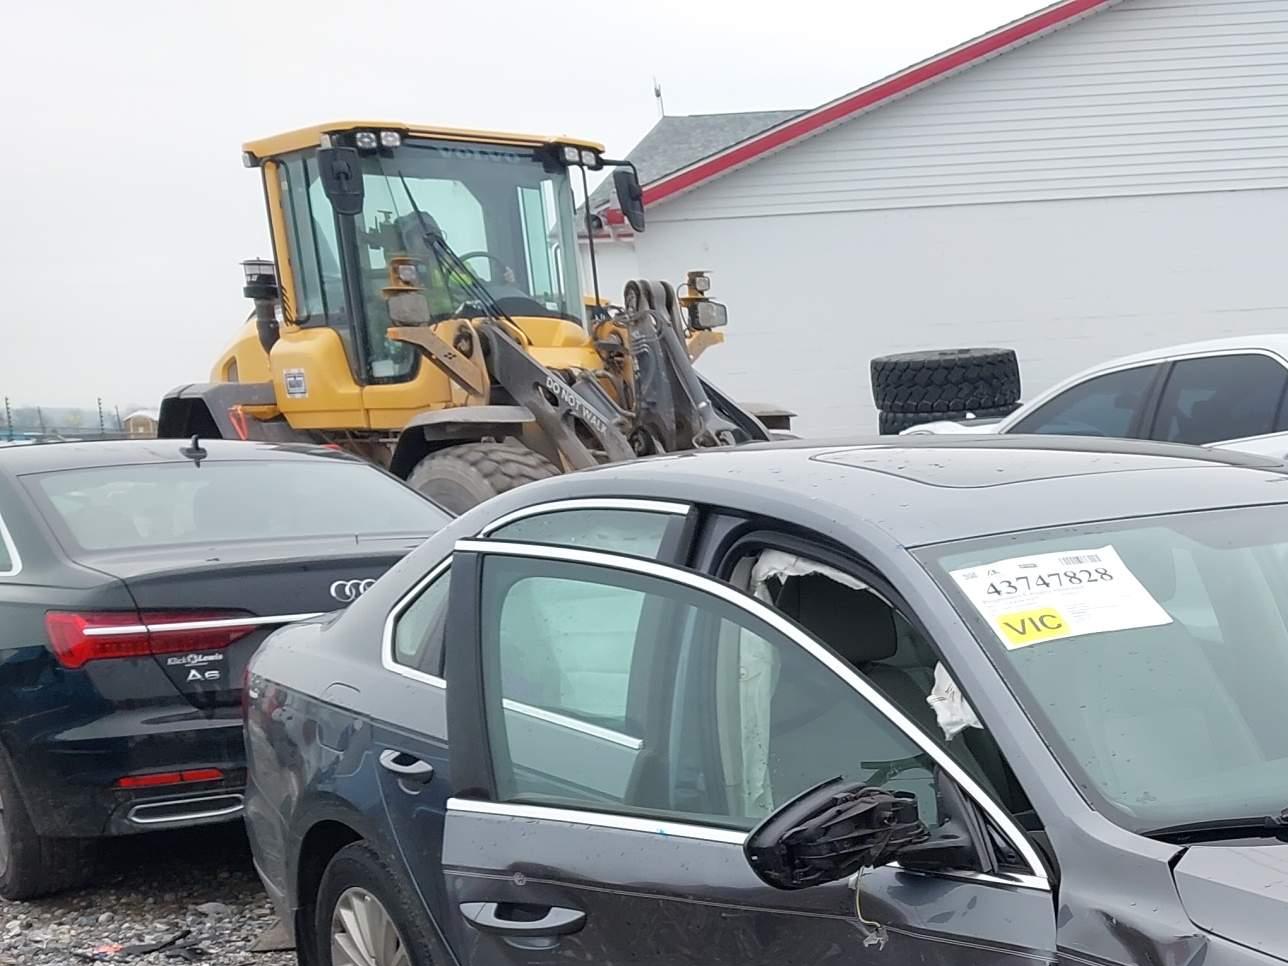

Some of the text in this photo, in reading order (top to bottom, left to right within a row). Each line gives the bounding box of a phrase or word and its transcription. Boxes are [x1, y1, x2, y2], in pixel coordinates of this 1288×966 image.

[546, 377, 607, 433] DO NOT WALK
[986, 567, 1114, 596] 43747828
[1003, 614, 1063, 636] VIC
[186, 669, 221, 681] A6
